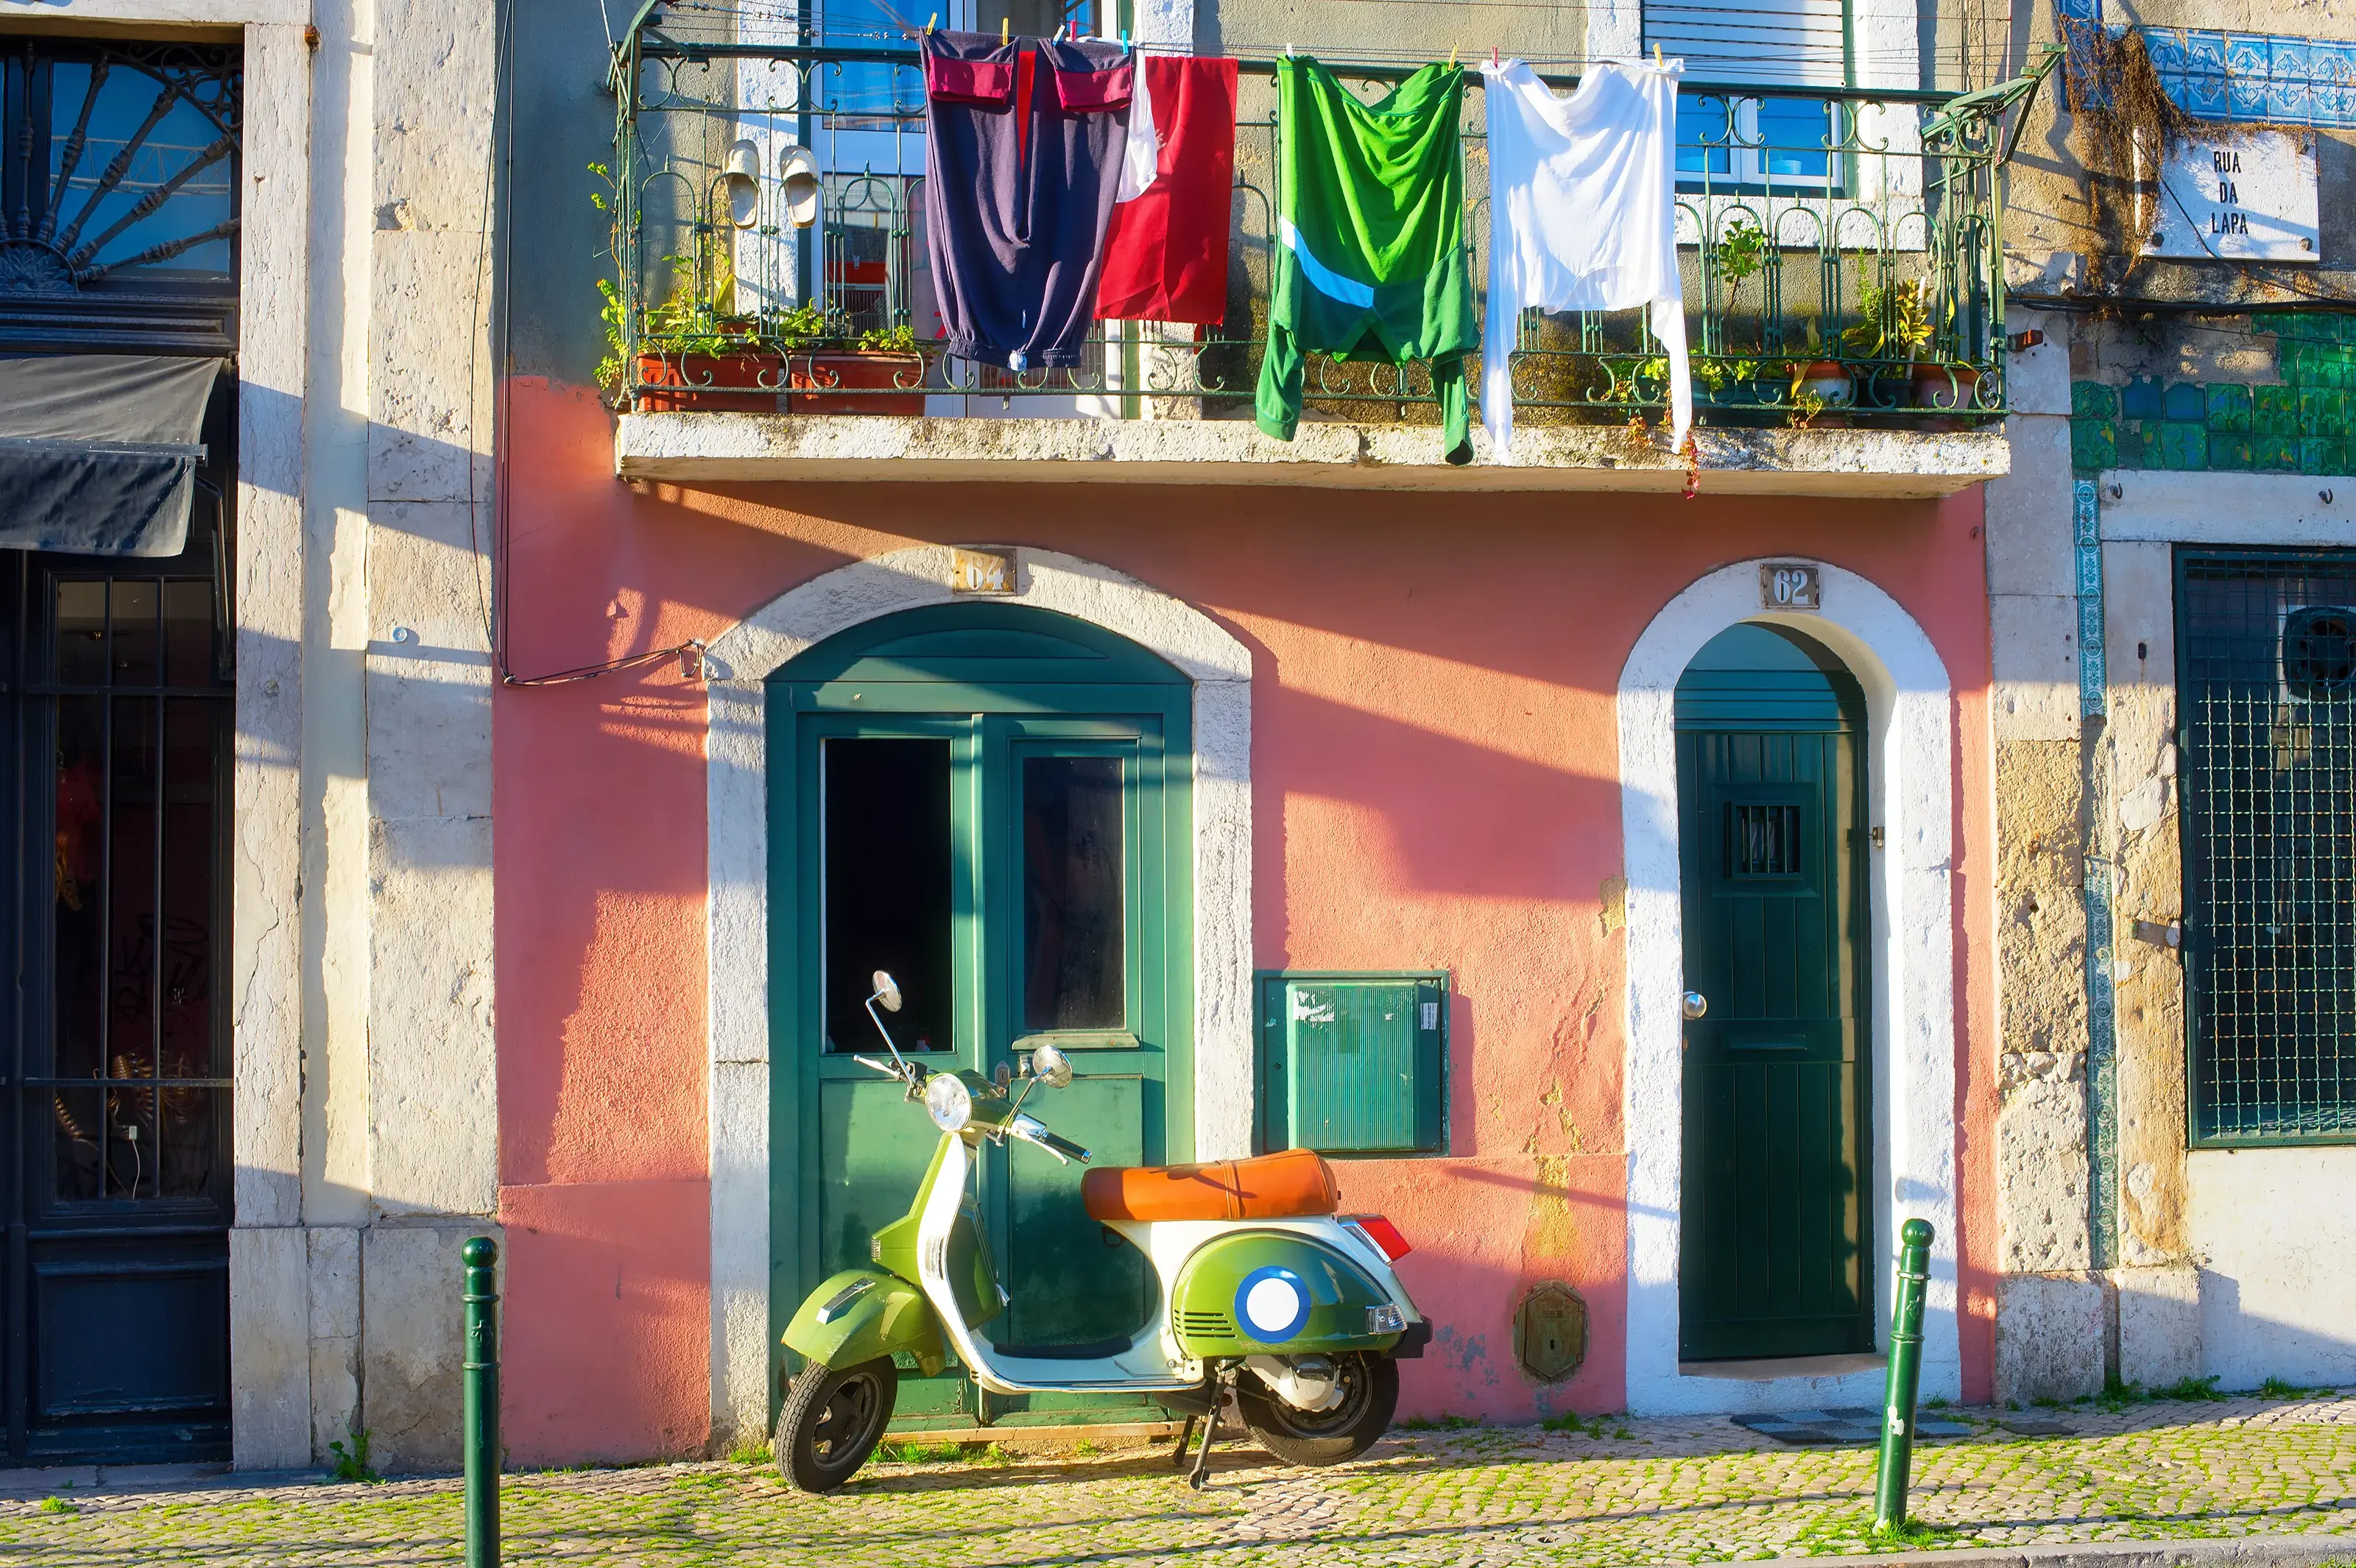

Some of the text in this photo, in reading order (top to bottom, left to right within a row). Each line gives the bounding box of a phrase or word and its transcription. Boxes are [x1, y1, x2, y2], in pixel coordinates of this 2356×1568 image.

[2214, 151, 2241, 173] RUA
[2219, 182, 2237, 204] DA
[2211, 212, 2249, 235] LAPA
[966, 555, 1004, 590] 64
[1774, 569, 1808, 604] 62
